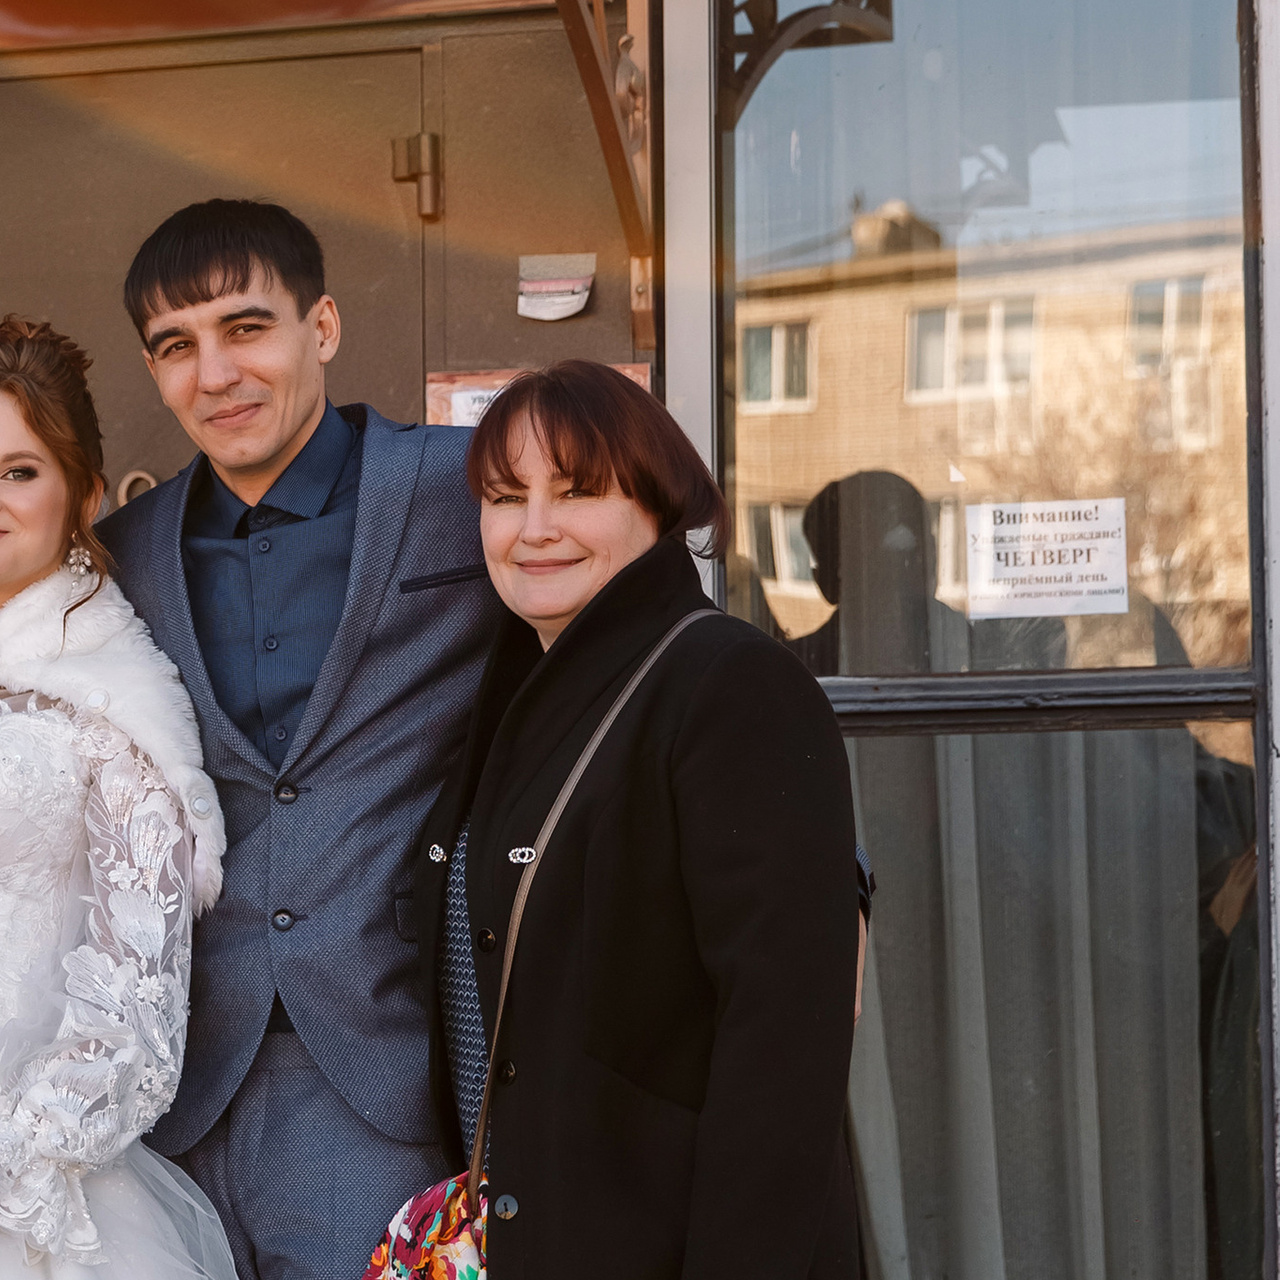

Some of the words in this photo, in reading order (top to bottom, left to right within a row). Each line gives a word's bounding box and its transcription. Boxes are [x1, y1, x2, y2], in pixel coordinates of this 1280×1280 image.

[992, 505, 1100, 526] Внимание!
[1053, 527, 1122, 543] граждане!
[996, 547, 1099, 568] ЧЕТВЕРГ
[1076, 573, 1108, 583] день
